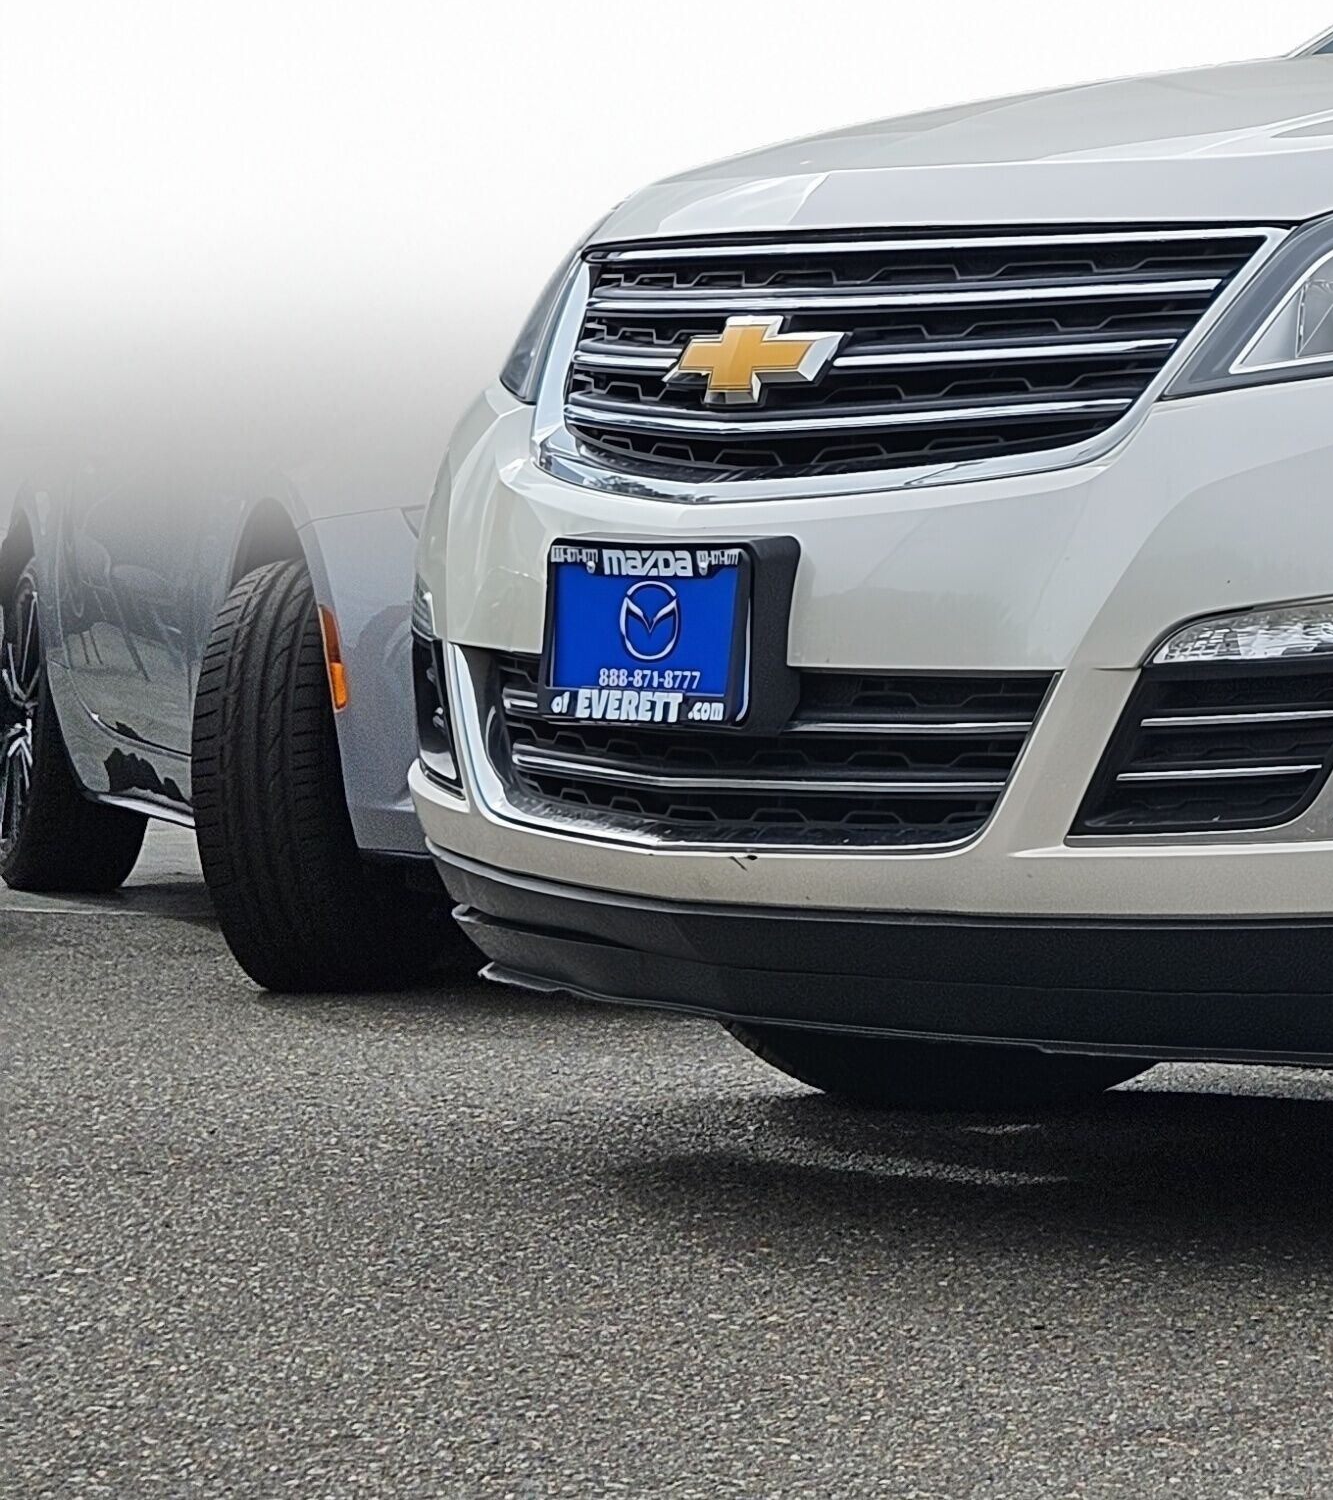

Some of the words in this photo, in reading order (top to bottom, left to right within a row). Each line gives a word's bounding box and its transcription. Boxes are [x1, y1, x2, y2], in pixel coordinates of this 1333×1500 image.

[599, 668, 700, 690] 888-871-8777
[550, 691, 570, 714] of
[574, 689, 683, 723] EVERETT
[687, 701, 724, 721] .com
